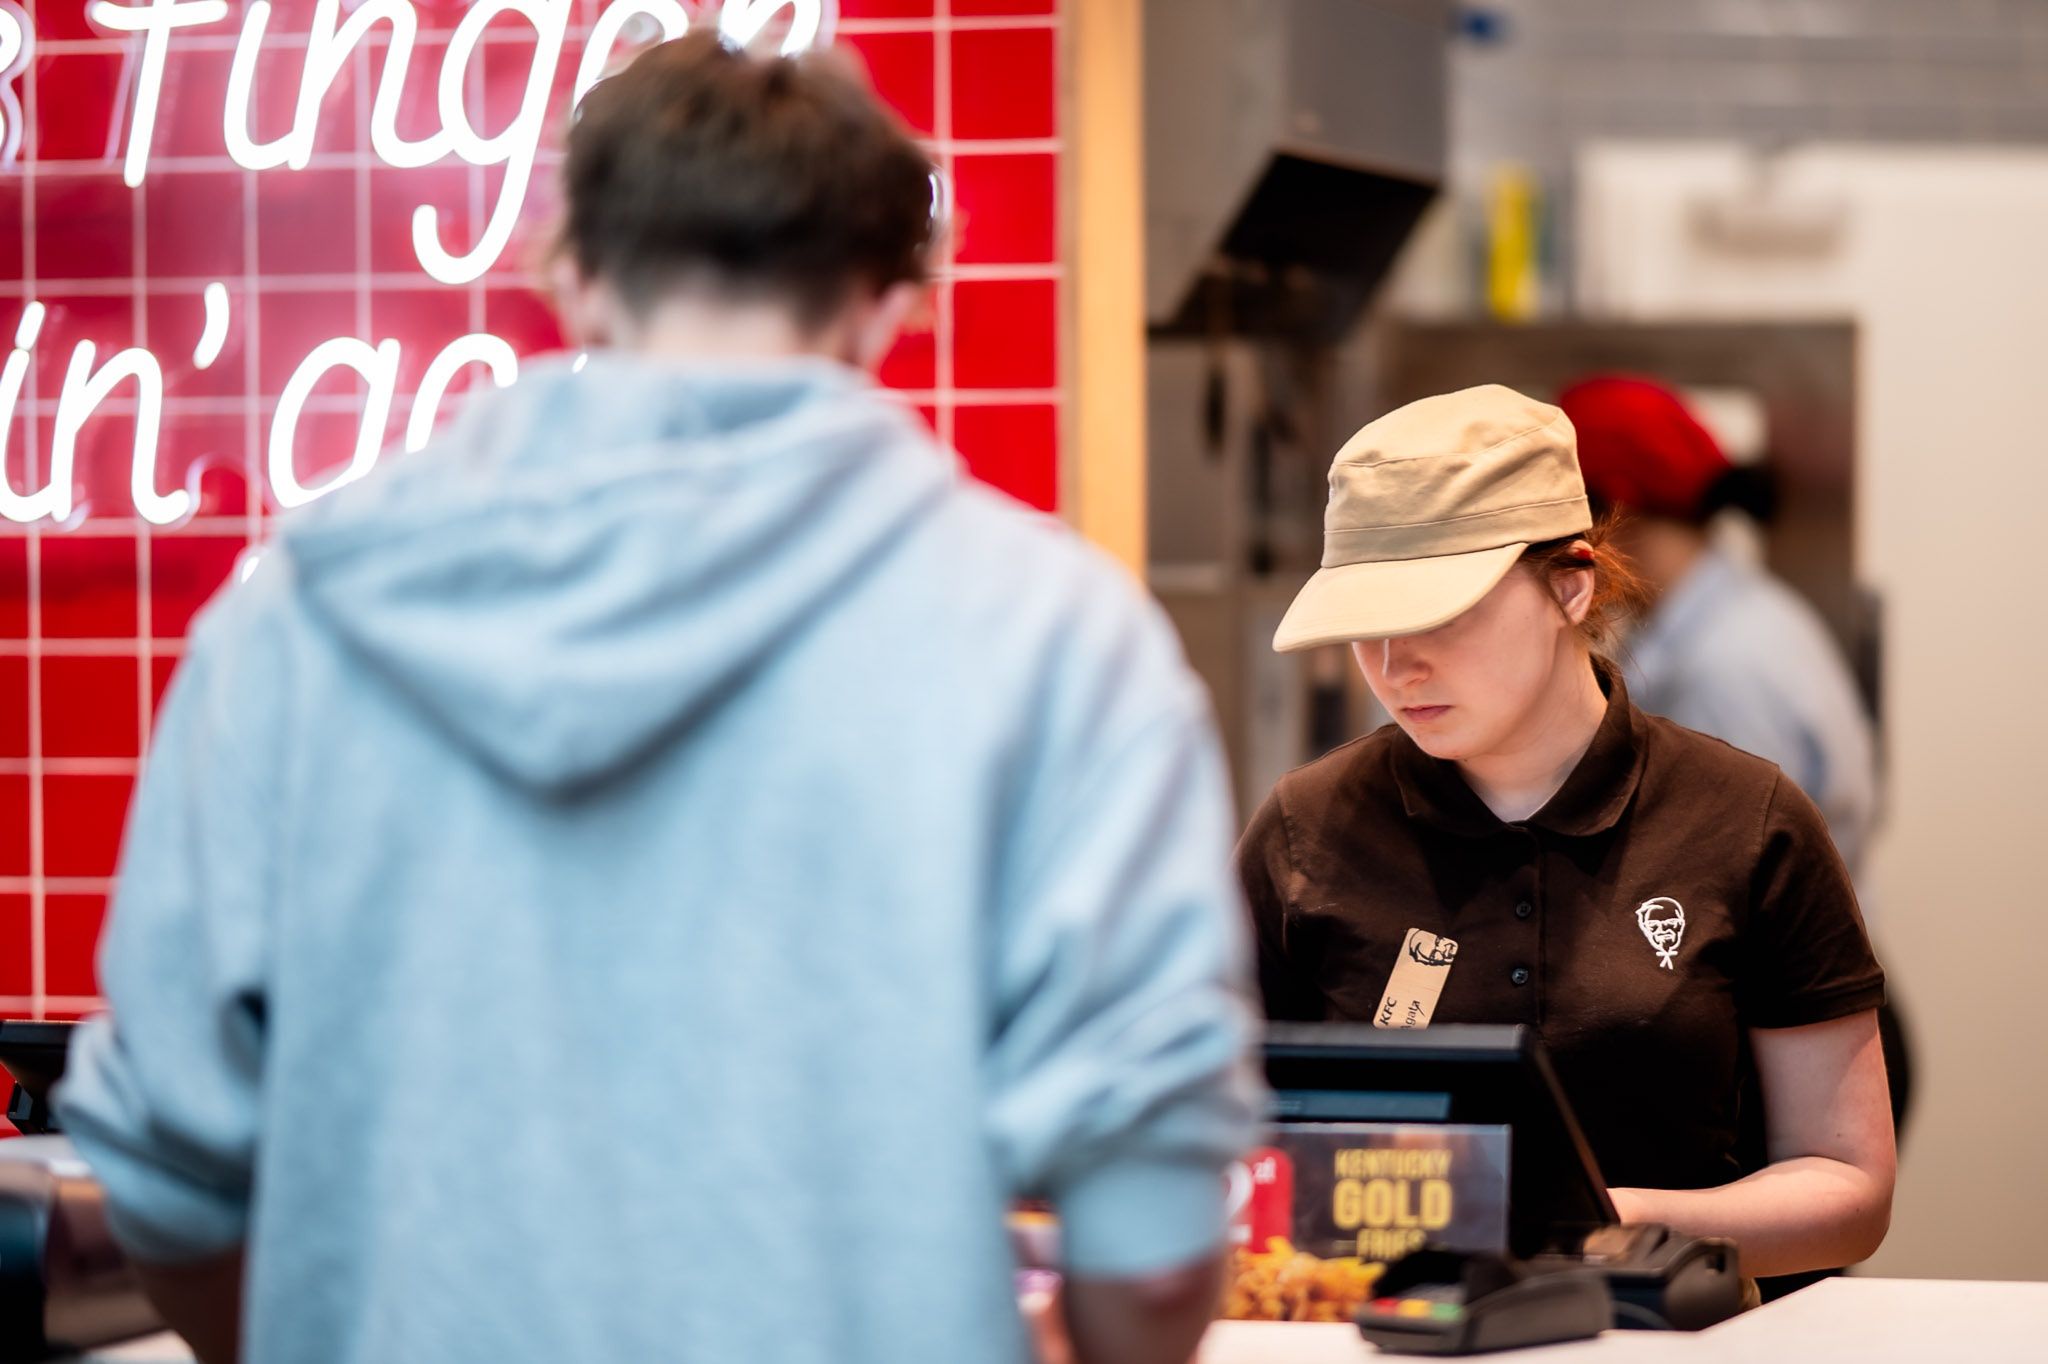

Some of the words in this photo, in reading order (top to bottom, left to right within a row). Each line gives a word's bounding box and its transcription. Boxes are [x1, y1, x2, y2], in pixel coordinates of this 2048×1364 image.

[1380, 996, 1397, 1026] KFC
[1335, 1148, 1453, 1178] KENTUCKY
[1333, 1178, 1453, 1231] GOLD
